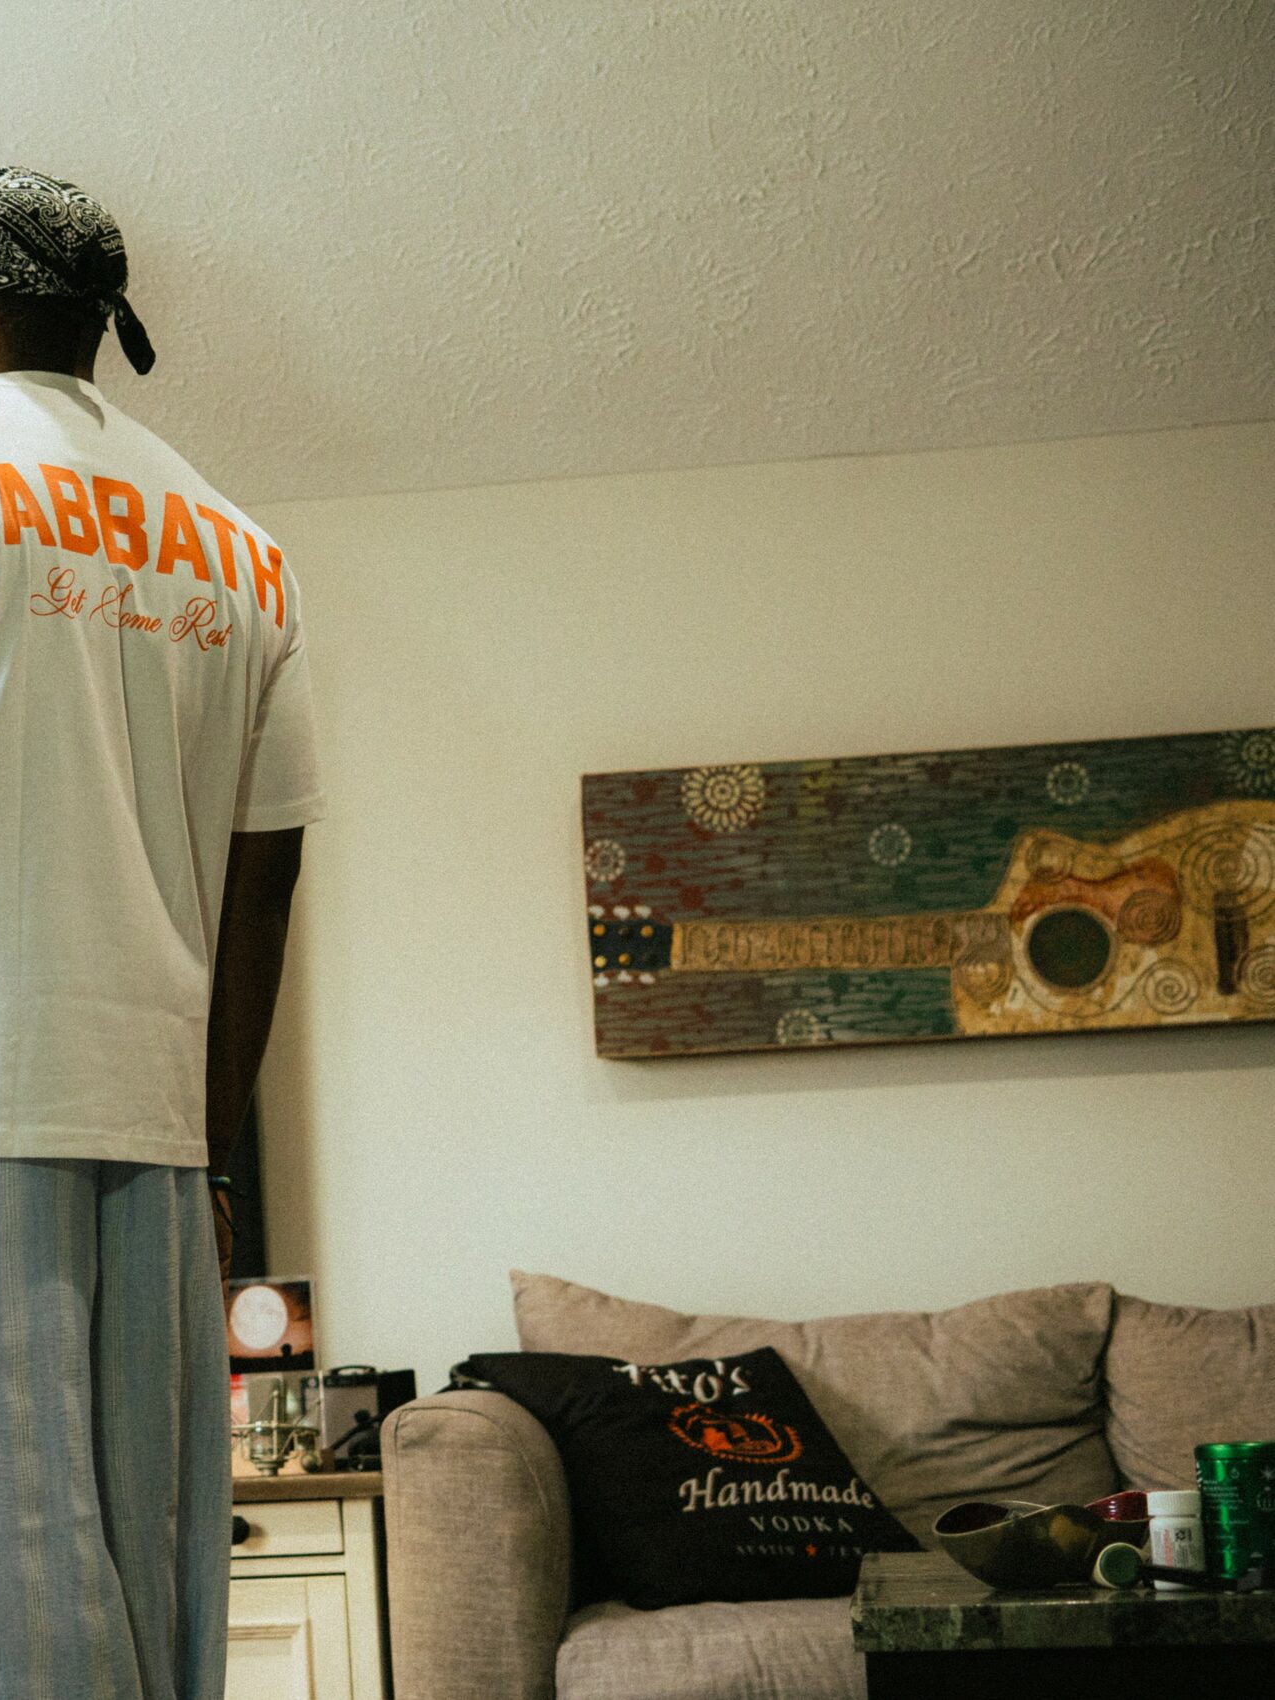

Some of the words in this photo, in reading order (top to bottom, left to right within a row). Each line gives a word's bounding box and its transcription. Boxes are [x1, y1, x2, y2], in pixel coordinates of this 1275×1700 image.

[30, 567, 87, 619] Get
[90, 583, 164, 634] Some
[169, 596, 233, 651] Rest
[613, 1360, 752, 1402] Tito's
[679, 1467, 876, 1513] Handmade
[749, 1515, 854, 1533] VODKA
